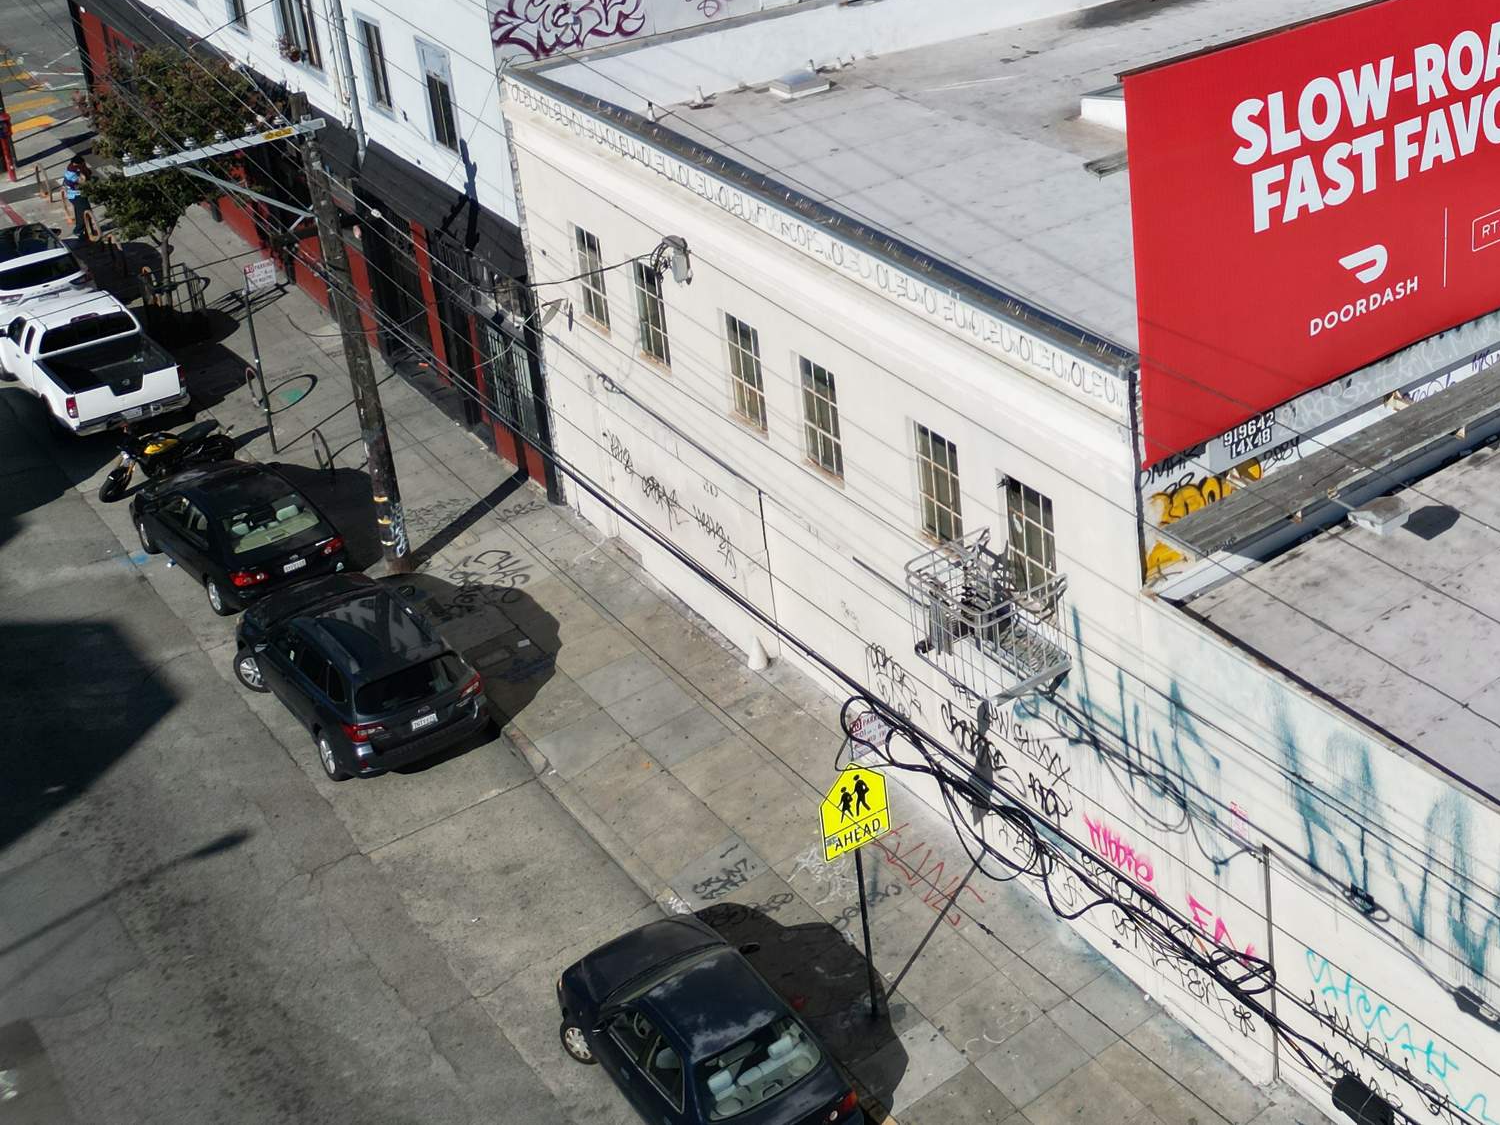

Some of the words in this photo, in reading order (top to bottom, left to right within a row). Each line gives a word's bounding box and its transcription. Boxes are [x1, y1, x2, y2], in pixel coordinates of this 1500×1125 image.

[1251, 130, 1384, 234] FAST
[1481, 220, 1500, 239] RT
[1309, 276, 1419, 337] DOORDASH
[1223, 411, 1275, 446] 919642
[1231, 429, 1272, 458] 14X48
[835, 818, 881, 851] AHEAD
